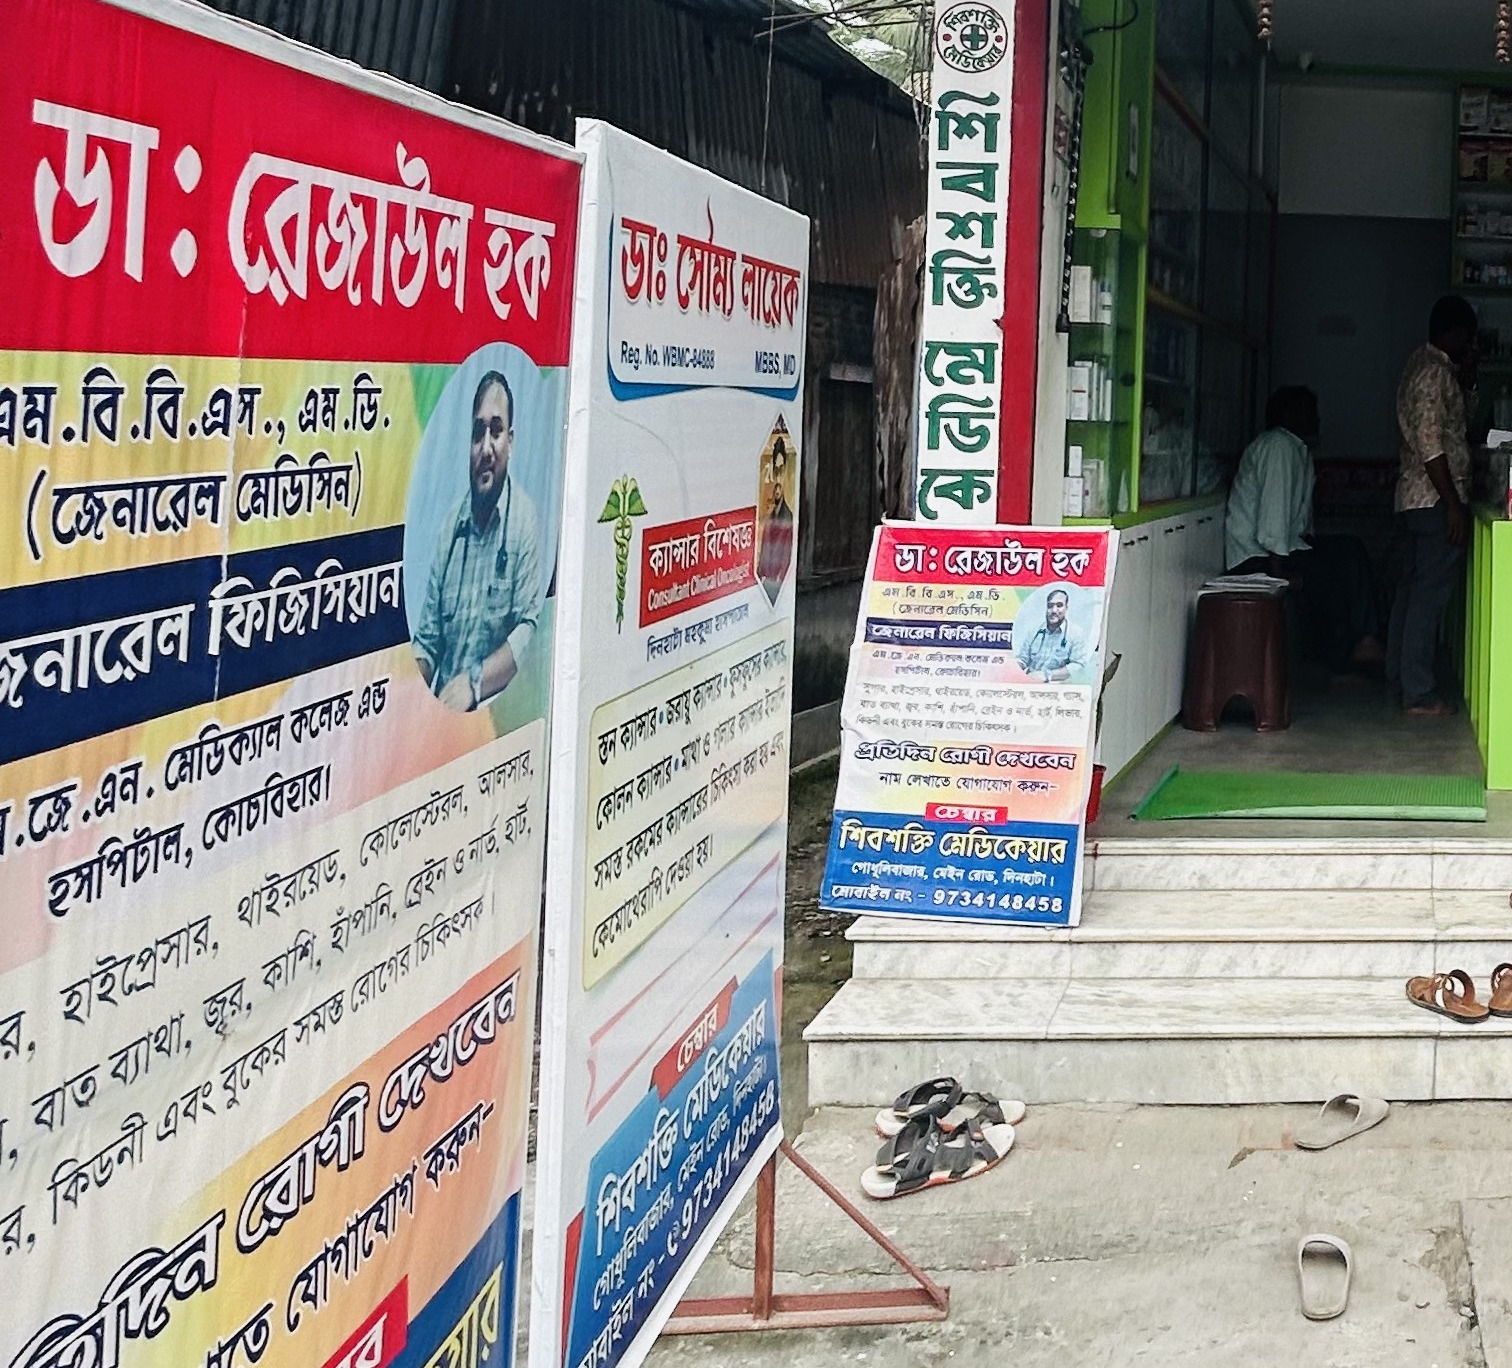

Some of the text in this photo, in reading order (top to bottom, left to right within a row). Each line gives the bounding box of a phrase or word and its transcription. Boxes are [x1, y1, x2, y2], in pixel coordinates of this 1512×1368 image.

[228, 141, 475, 314] রেজাউল
[484, 207, 557, 322] হক
[929, 90, 1001, 309] শিবশক্তি
[620, 216, 668, 303] ডাঃ
[742, 253, 801, 329] লায়েক
[620, 340, 643, 371] Reg.
[918, 340, 999, 520] মেডিকে
[235, 450, 363, 523] মেডিসিন)
[647, 581, 690, 612] Consultant
[944, 537, 1046, 577] রেজাউল
[1050, 548, 1094, 578] হক
[0, 558, 404, 708] জনারেল ফিজিসিয়ান
[165, 714, 285, 792] মেডিক্যাল
[290, 690, 354, 744] কলেজ
[854, 739, 1077, 770] প্রতিদিন রোগী দেখবেন
[878, 771, 902, 785] নাম
[838, 818, 1069, 865] শিবশক্তি মেডিকেয়ার
[934, 804, 998, 823] চেম্বার
[48, 822, 193, 918] হসপিটাল,
[831, 882, 1064, 914] মোবাইল নং 9734148458
[32, 1063, 101, 1133] বাত
[261, 928, 322, 993] কাশি,
[453, 848, 467, 876] ও
[676, 1002, 719, 1073] চেম্বার
[47, 1111, 149, 1226] কিডনী
[156, 1081, 216, 1142] এবং
[220, 1028, 289, 1110] বুকের
[294, 989, 346, 1044] সমস্ত
[350, 943, 411, 1013] রোগের
[595, 1107, 680, 1257] শিবশক্তি
[683, 998, 767, 1140] মেডিকেয়ার
[6, 1209, 227, 1368] তিদিন
[235, 1081, 371, 1254] রোগী
[378, 968, 523, 1134] দেখবেন
[681, 1079, 775, 1240] 9734148458
[287, 1161, 419, 1334] যোগাযোগ
